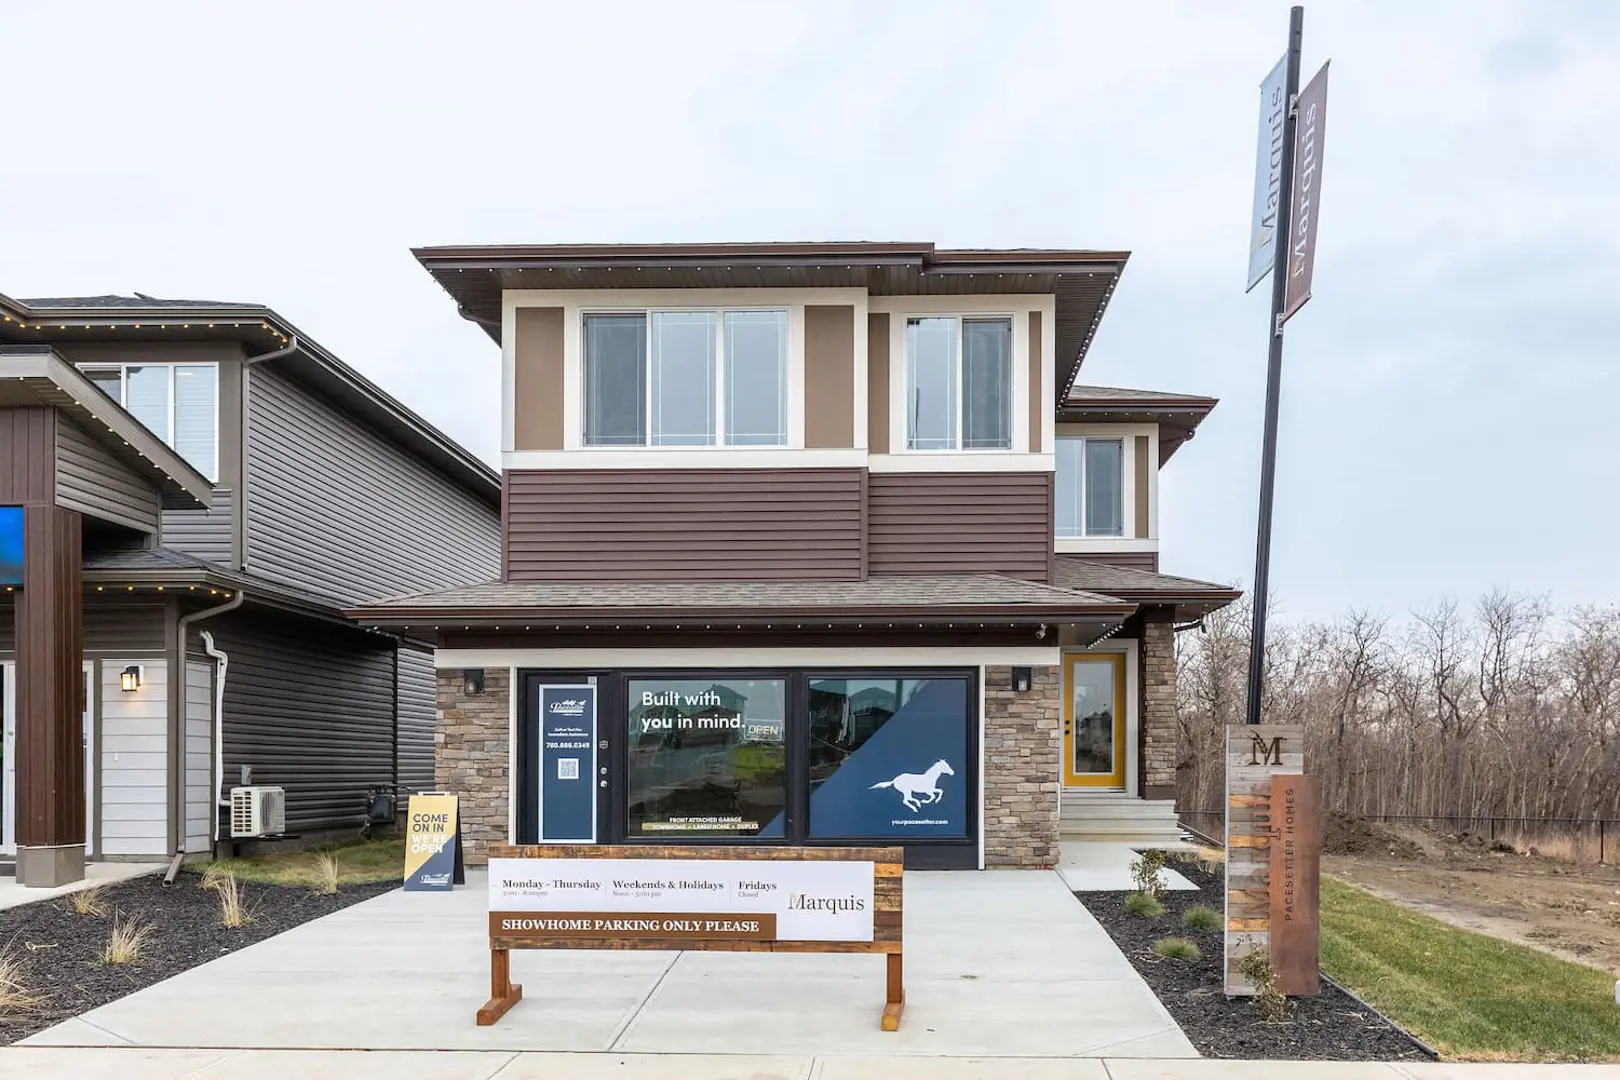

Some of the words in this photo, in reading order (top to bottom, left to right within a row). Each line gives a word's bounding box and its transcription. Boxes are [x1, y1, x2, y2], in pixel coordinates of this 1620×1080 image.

[1293, 102, 1317, 278] Marquis
[641, 690, 681, 706] Built
[684, 690, 721, 706] with
[641, 716, 673, 733] you
[677, 713, 693, 729] in
[698, 713, 746, 729] mind.
[748, 724, 778, 735] OPEN
[1247, 729, 1288, 766] M
[1285, 788, 1295, 834] HOMES
[413, 813, 448, 823] COME
[412, 823, 430, 832] ON
[433, 823, 444, 832] IN
[411, 834, 448, 844] WE'RE
[411, 844, 443, 854] OPEN
[502, 879, 544, 890] Monday
[553, 879, 602, 891] Thursday
[612, 880, 666, 889] Weekends
[668, 881, 677, 889] &
[678, 880, 724, 891] Holidays
[738, 881, 777, 891] Fridays
[1285, 840, 1295, 921] PACESETTER
[788, 892, 865, 914] Marquis
[502, 919, 591, 930] SHOWHOME
[594, 919, 660, 931] PARKING
[662, 920, 702, 931] ONLY
[705, 921, 760, 932] PLEASE
